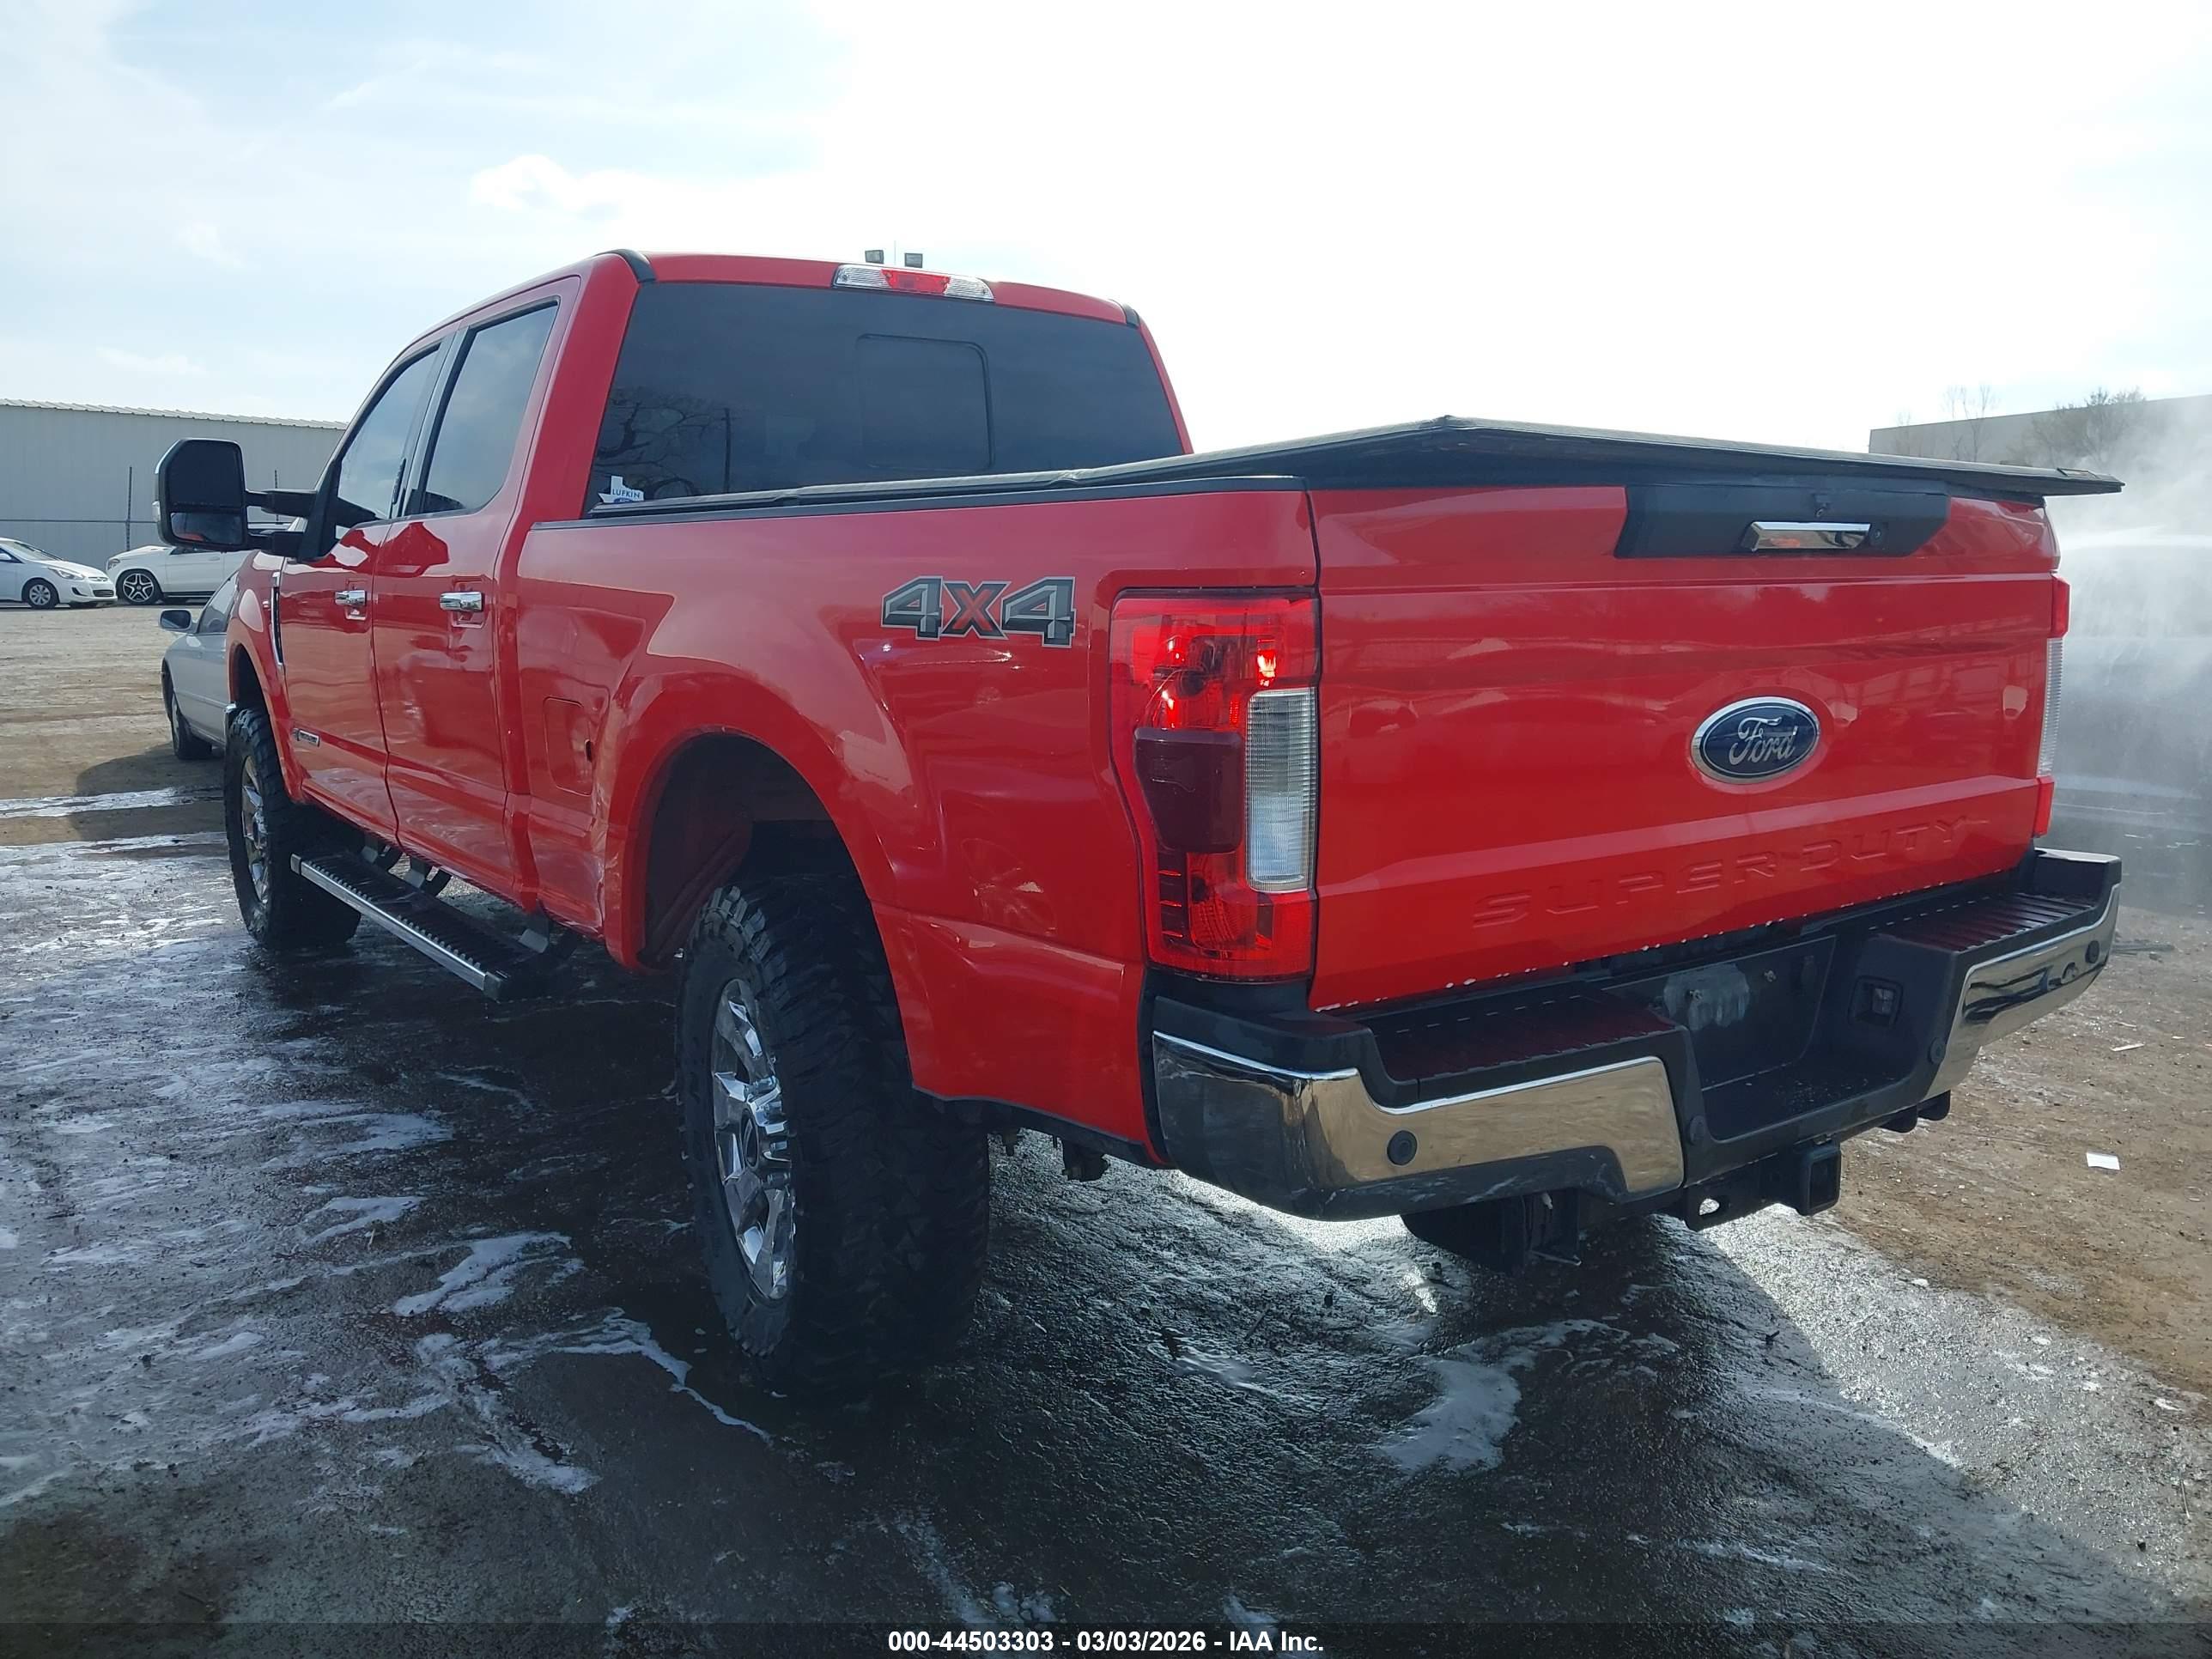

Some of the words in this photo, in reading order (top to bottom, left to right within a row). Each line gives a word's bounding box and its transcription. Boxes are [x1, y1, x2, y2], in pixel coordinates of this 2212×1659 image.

[612, 488, 641, 499] LUFKIN
[1729, 717, 1798, 765] Ford
[1472, 850, 1777, 928] SUPER
[1800, 815, 1967, 872] DUTY
